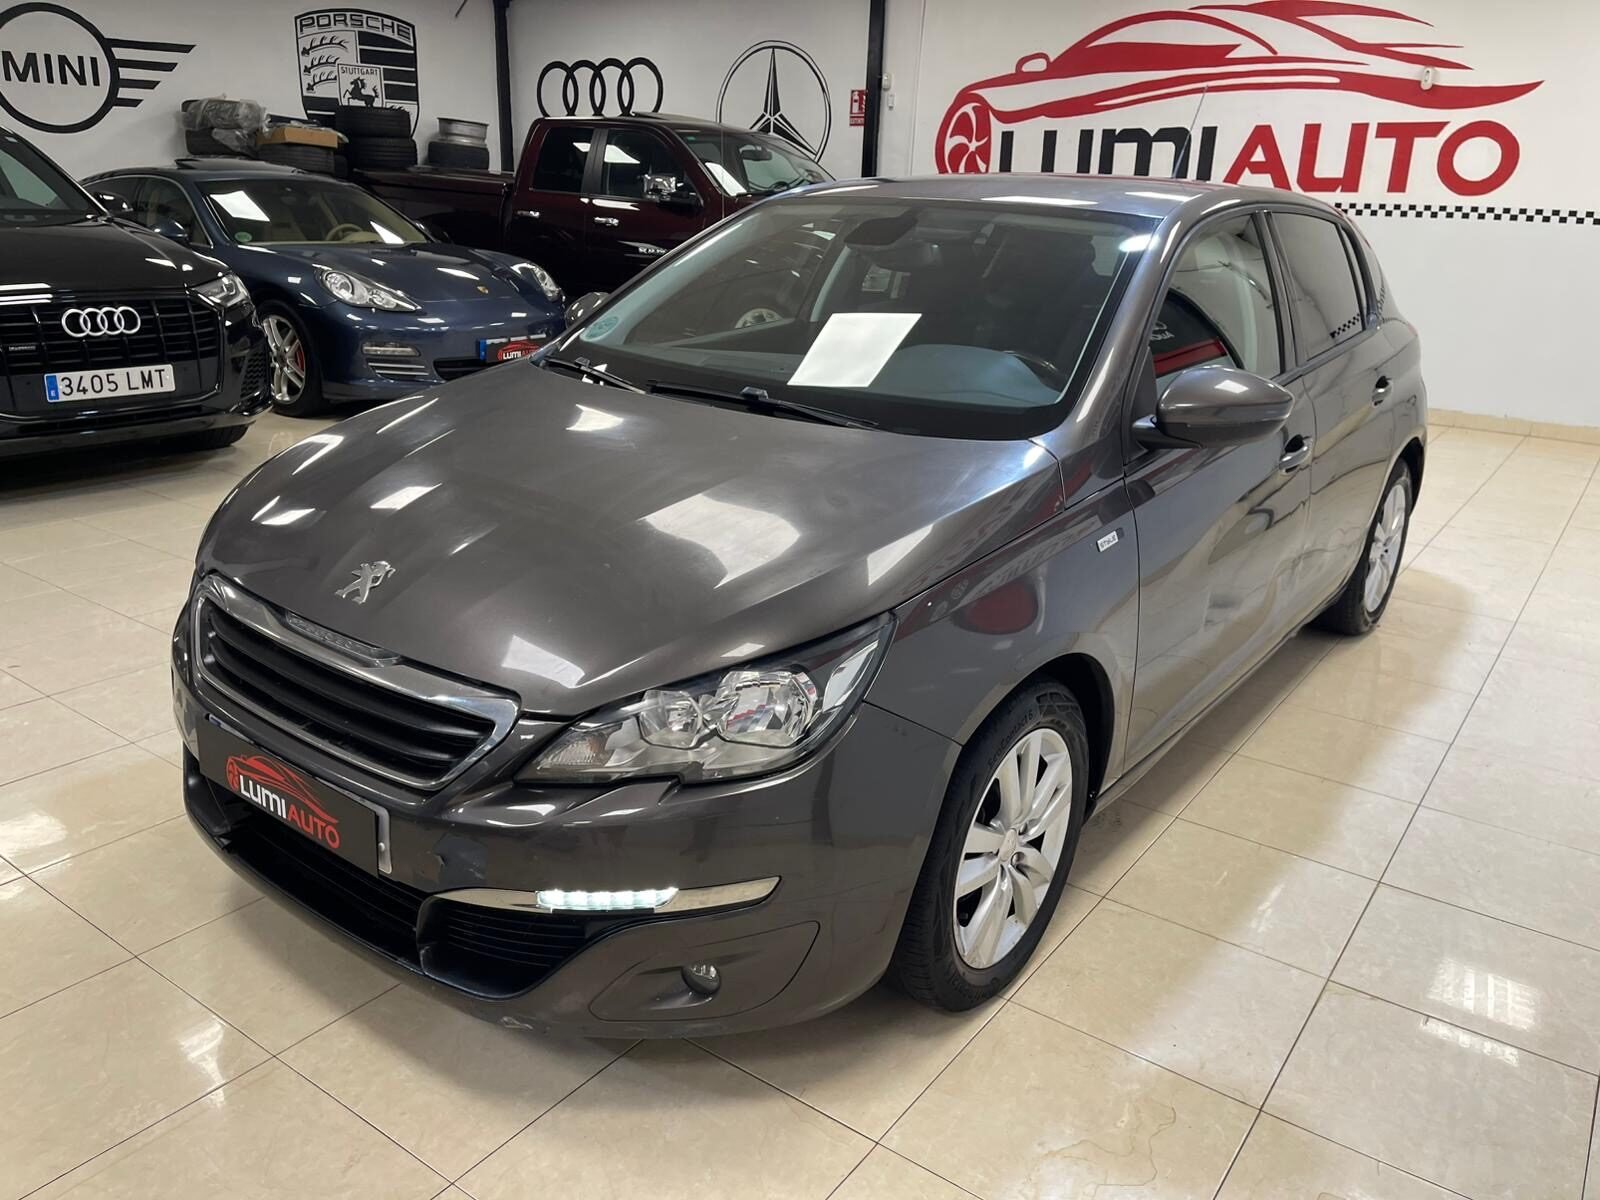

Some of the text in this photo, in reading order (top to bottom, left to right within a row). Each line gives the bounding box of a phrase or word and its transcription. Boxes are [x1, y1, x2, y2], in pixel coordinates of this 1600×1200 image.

[299, 13, 411, 40] PORSCHE
[2, 50, 100, 86] MINI
[340, 66, 378, 76] STUTTGART
[60, 369, 165, 396] 3405 LMT
